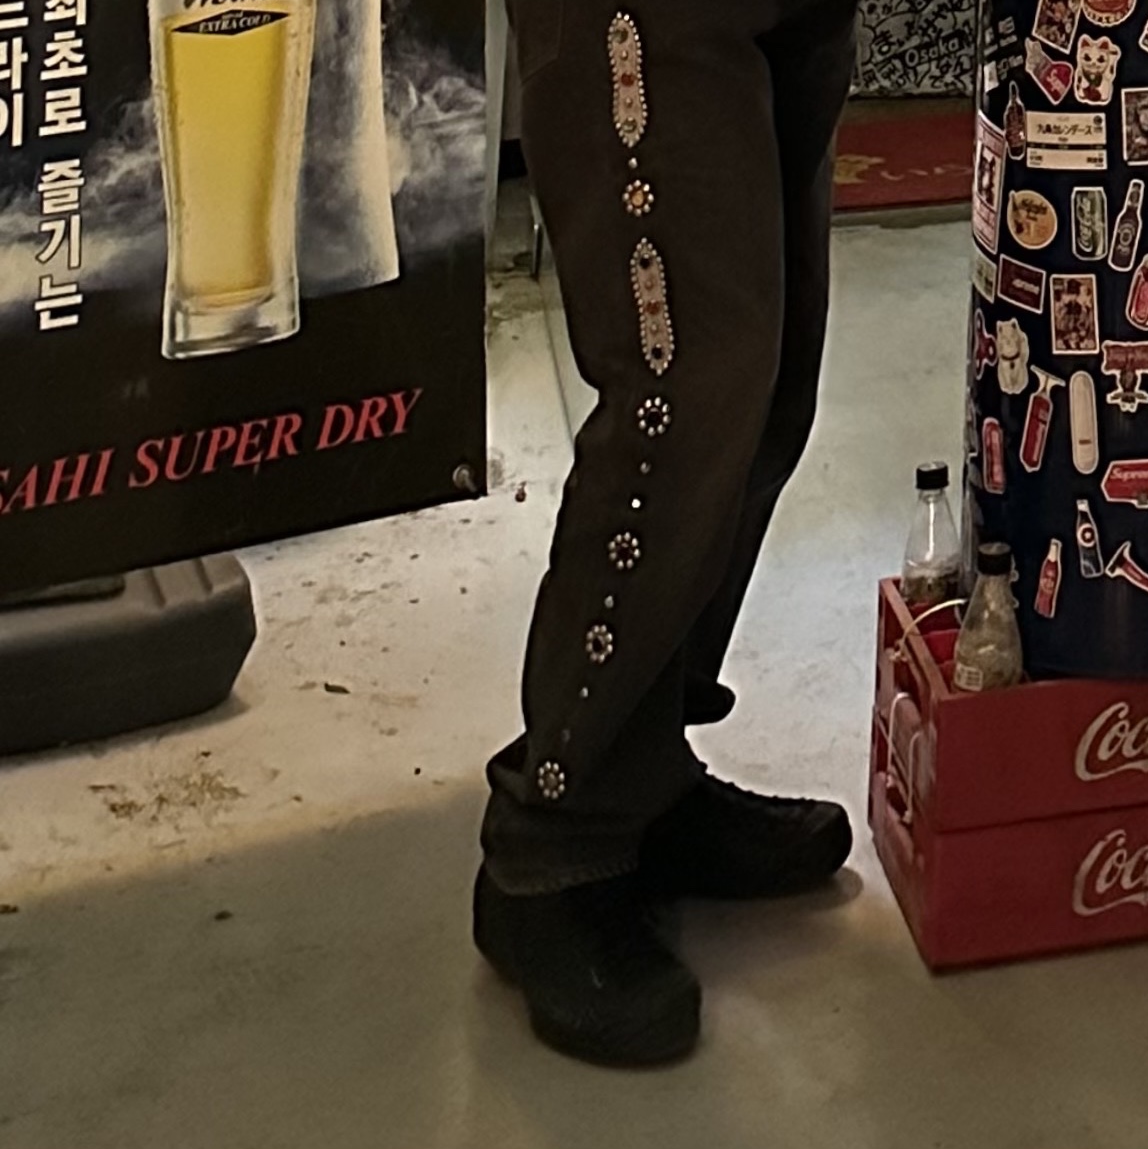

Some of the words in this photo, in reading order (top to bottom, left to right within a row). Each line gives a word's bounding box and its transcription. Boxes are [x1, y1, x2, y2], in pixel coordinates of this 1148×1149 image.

[199, 20, 237, 33] EXTRA
[904, 36, 960, 69] Osaka
[0, 448, 114, 514] AHI
[129, 412, 302, 488] SUPER
[316, 389, 423, 450] DRY
